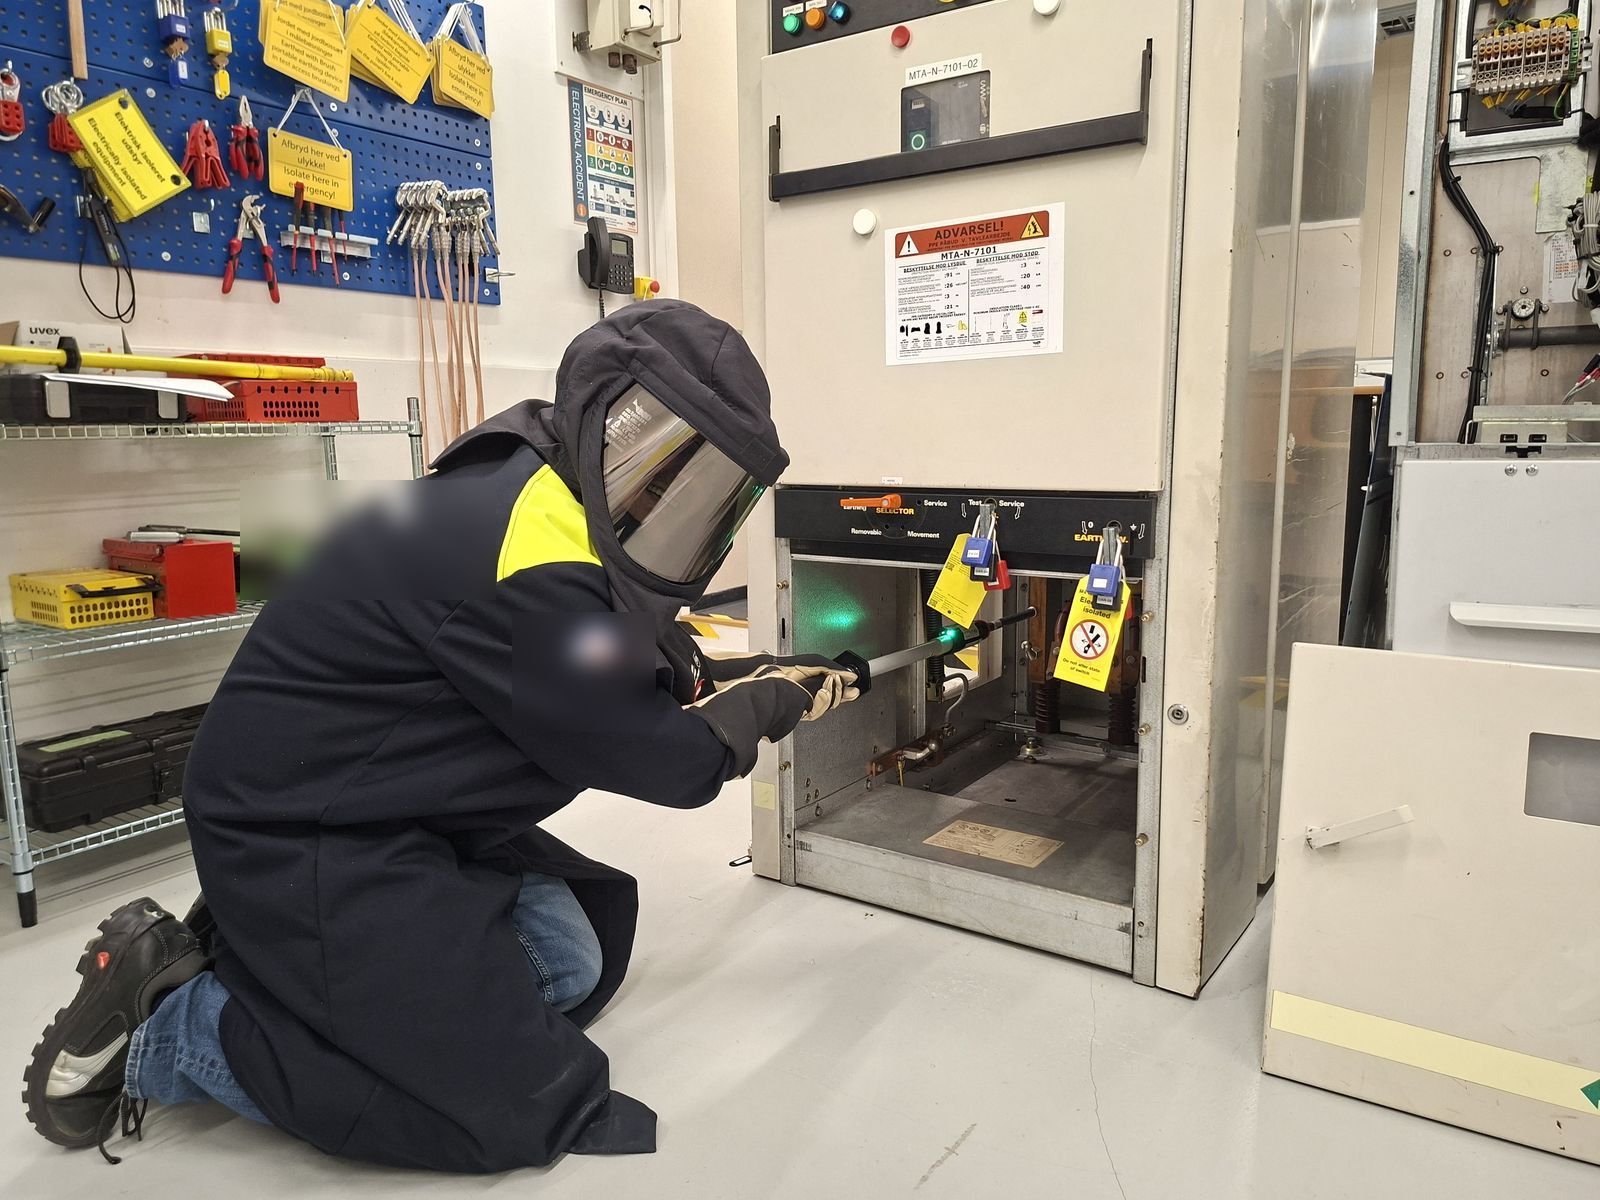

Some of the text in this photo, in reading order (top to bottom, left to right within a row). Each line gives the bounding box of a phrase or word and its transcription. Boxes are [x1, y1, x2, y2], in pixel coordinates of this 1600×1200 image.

[271, 45, 298, 61] portable
[324, 69, 343, 83] device
[305, 51, 319, 63] with
[466, 57, 476, 68] her
[475, 64, 486, 75] ved
[908, 58, 978, 81] MTA-N-7101-02
[448, 69, 484, 97] Isolate here in
[584, 86, 628, 107] EMERGENCY PLAN
[114, 112, 166, 183] Elektrisk isoleret
[121, 138, 143, 166] udstyr
[281, 139, 340, 163] Afbryd her ved
[572, 90, 585, 201] ELECTRICAL ACCIDENT
[88, 117, 123, 166] Electrically
[121, 167, 148, 200] isolated
[92, 141, 127, 187] equipment
[297, 156, 326, 171] ulykke!
[283, 166, 340, 188] Isolate here in
[288, 181, 336, 200] ergency!
[934, 220, 1004, 241] ADVARSEL!
[940, 246, 997, 261] MTA-N-7101
[976, 254, 1010, 264] BESKYTTELSE
[903, 266, 935, 274] BESKYTTELSE
[29, 326, 60, 336] uvex
[876, 507, 914, 515] SELECTOR
[907, 530, 940, 539] Movement
[1083, 607, 1112, 619] isolated
[1075, 668, 1090, 676] switch
